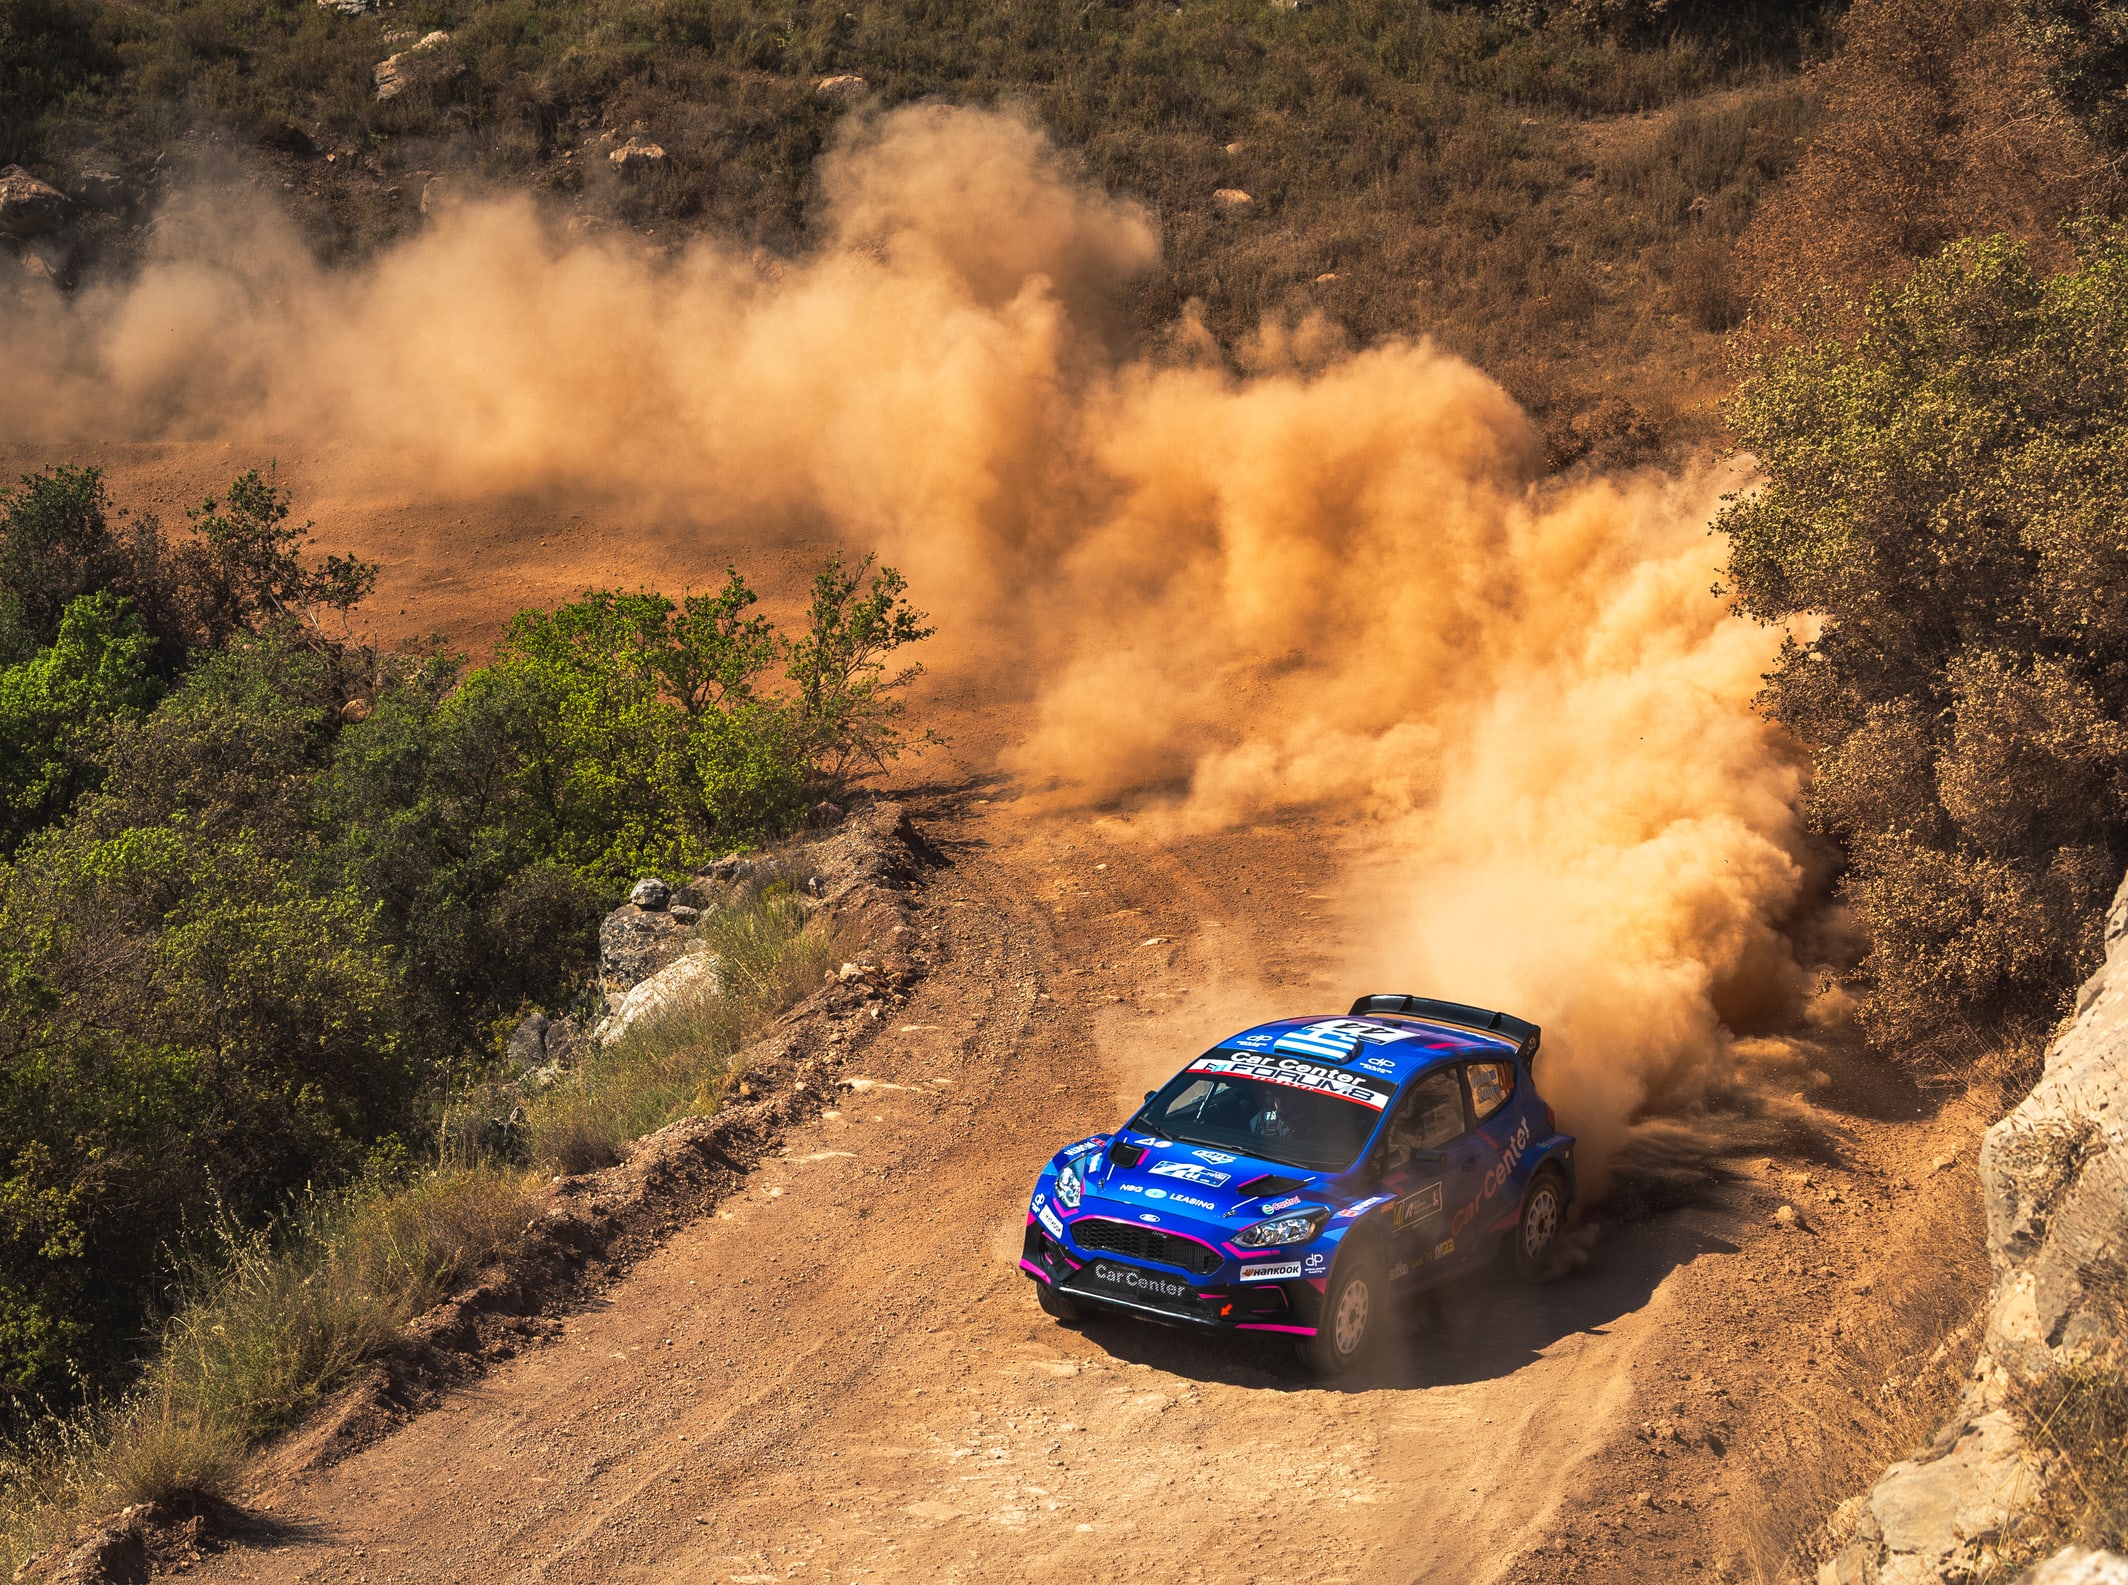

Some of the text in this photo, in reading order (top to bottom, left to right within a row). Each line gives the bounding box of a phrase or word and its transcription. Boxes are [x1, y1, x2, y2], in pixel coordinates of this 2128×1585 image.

[1230, 1051, 1275, 1067] Car
[1278, 1057, 1366, 1086] Center
[1230, 1062, 1375, 1101] FORUM8
[1450, 1190, 1484, 1236] Car
[1483, 1116, 1531, 1200] Center
[1119, 1183, 1216, 1211] NBG LEASING
